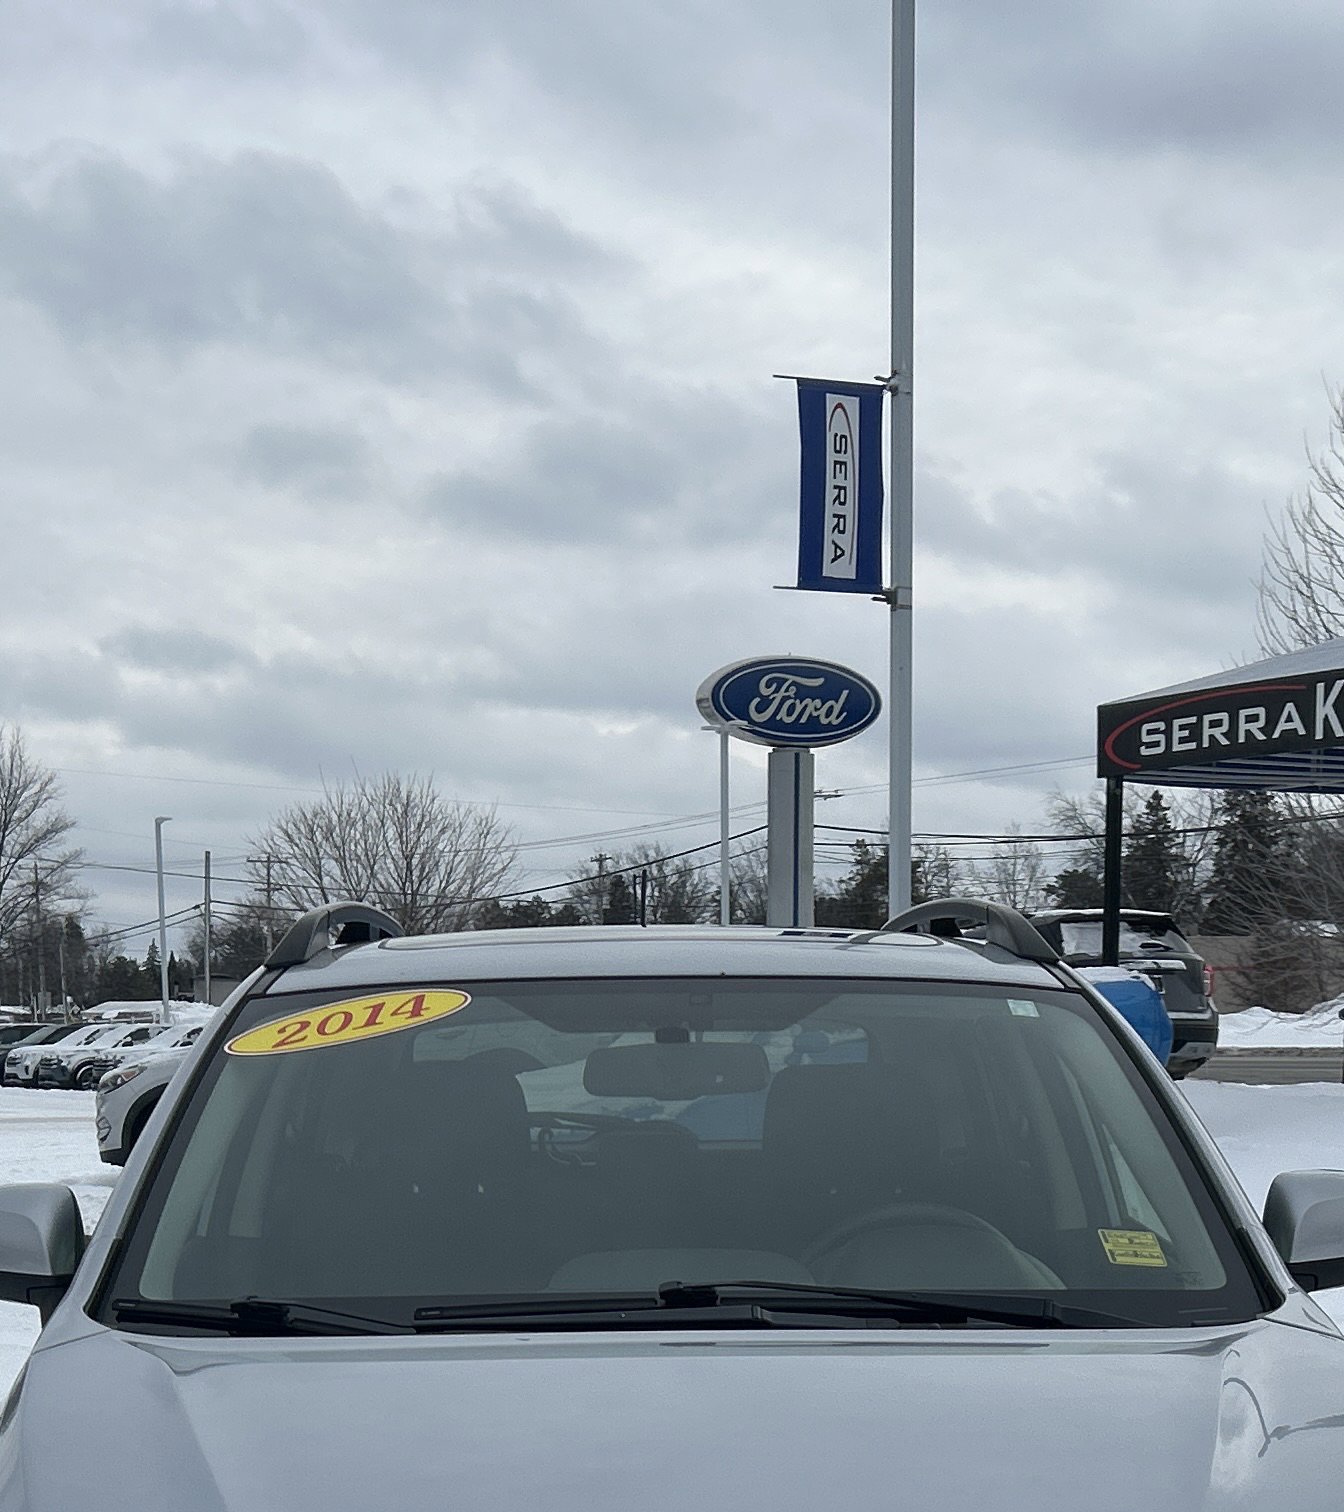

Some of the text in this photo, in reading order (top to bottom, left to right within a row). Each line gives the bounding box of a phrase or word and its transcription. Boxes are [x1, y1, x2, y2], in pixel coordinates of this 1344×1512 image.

[829, 431, 849, 565] SERRA
[748, 672, 850, 726] Ford
[1138, 700, 1307, 757] SERRA
[271, 993, 432, 1050] 2014
